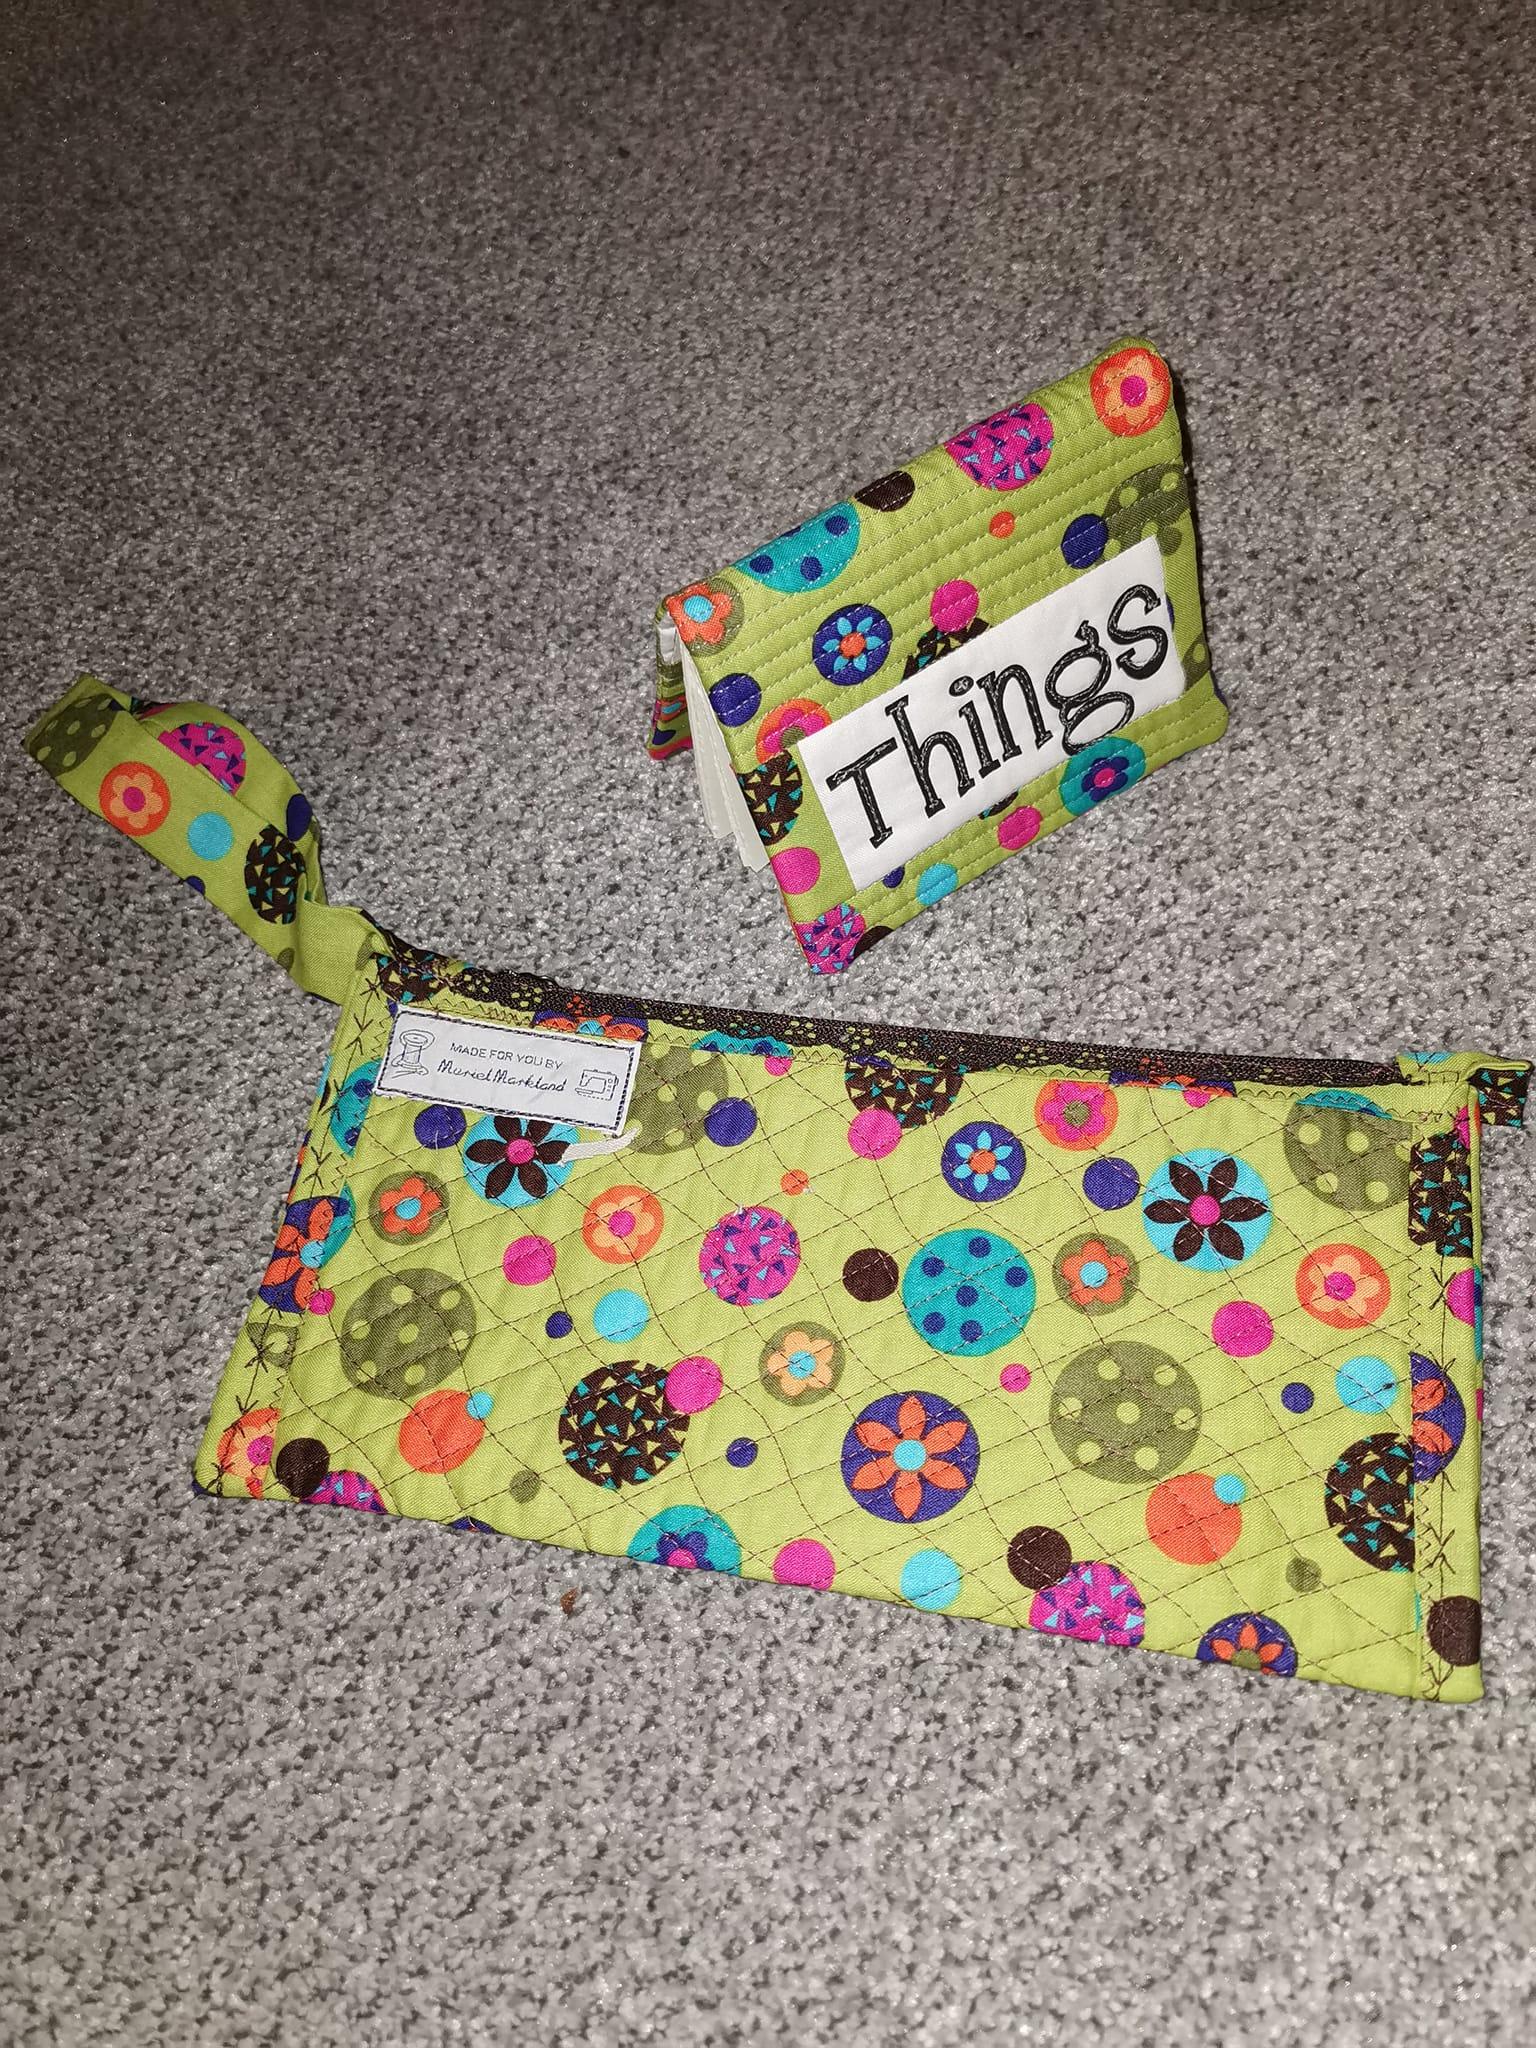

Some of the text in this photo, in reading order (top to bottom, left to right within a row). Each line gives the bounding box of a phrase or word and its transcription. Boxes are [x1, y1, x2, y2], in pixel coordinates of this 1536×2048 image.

[826, 584, 1169, 849] Things
[450, 1042, 563, 1071] MADE FOR YOU BY
